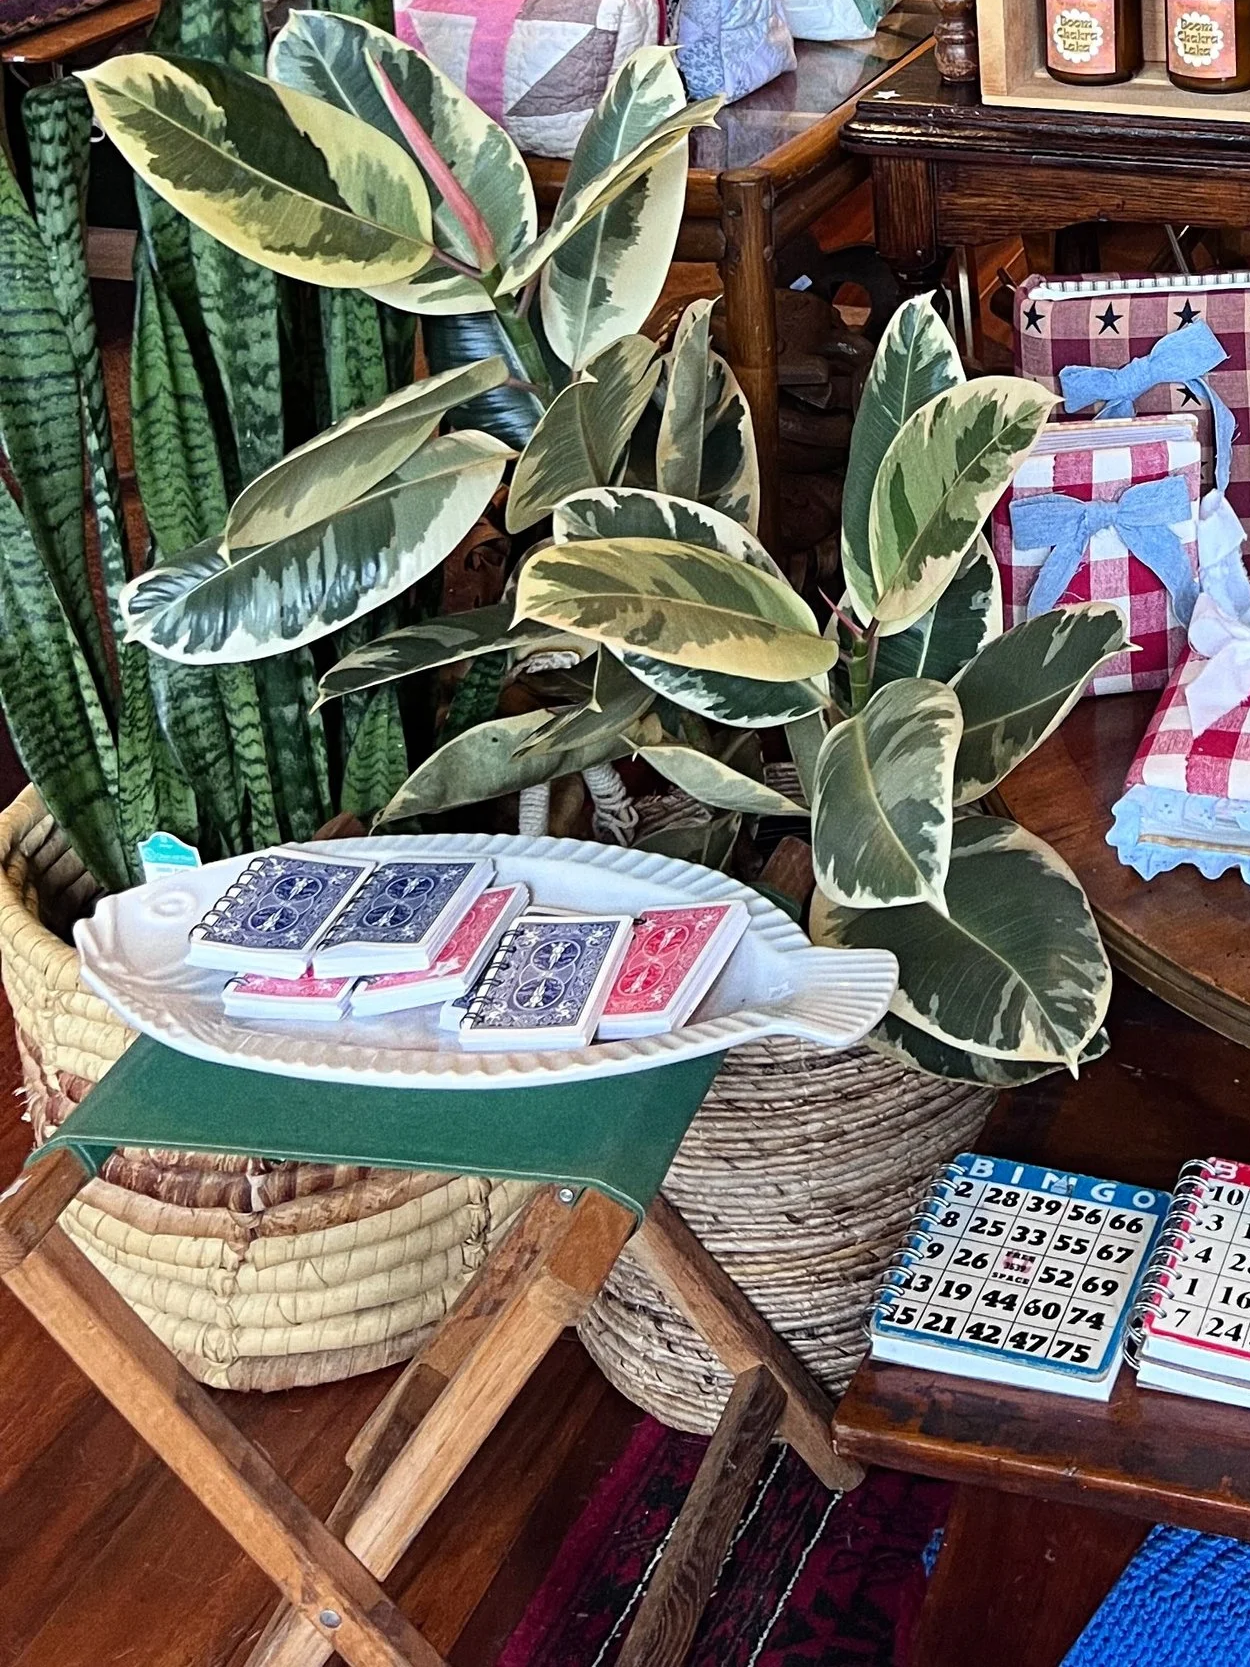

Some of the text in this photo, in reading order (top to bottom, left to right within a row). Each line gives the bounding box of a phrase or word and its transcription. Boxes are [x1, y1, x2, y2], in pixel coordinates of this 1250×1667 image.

[955, 1181, 1144, 1234] 2 28 39 56 66
[1209, 1186, 1244, 1206] 10
[941, 1211, 1135, 1264] 8 25 33 55 67
[1205, 1214, 1224, 1231] 3
[926, 1243, 1119, 1297] 9 26 52 69
[1194, 1247, 1213, 1263] 4
[991, 1272, 1030, 1284] SPACE
[1185, 1278, 1198, 1296] 1
[903, 1274, 1105, 1330] 13 19 44 60 74
[883, 1305, 1091, 1363] 15 21 42 47 75
[1175, 1308, 1191, 1327] 7
[1206, 1317, 1243, 1342] 24
